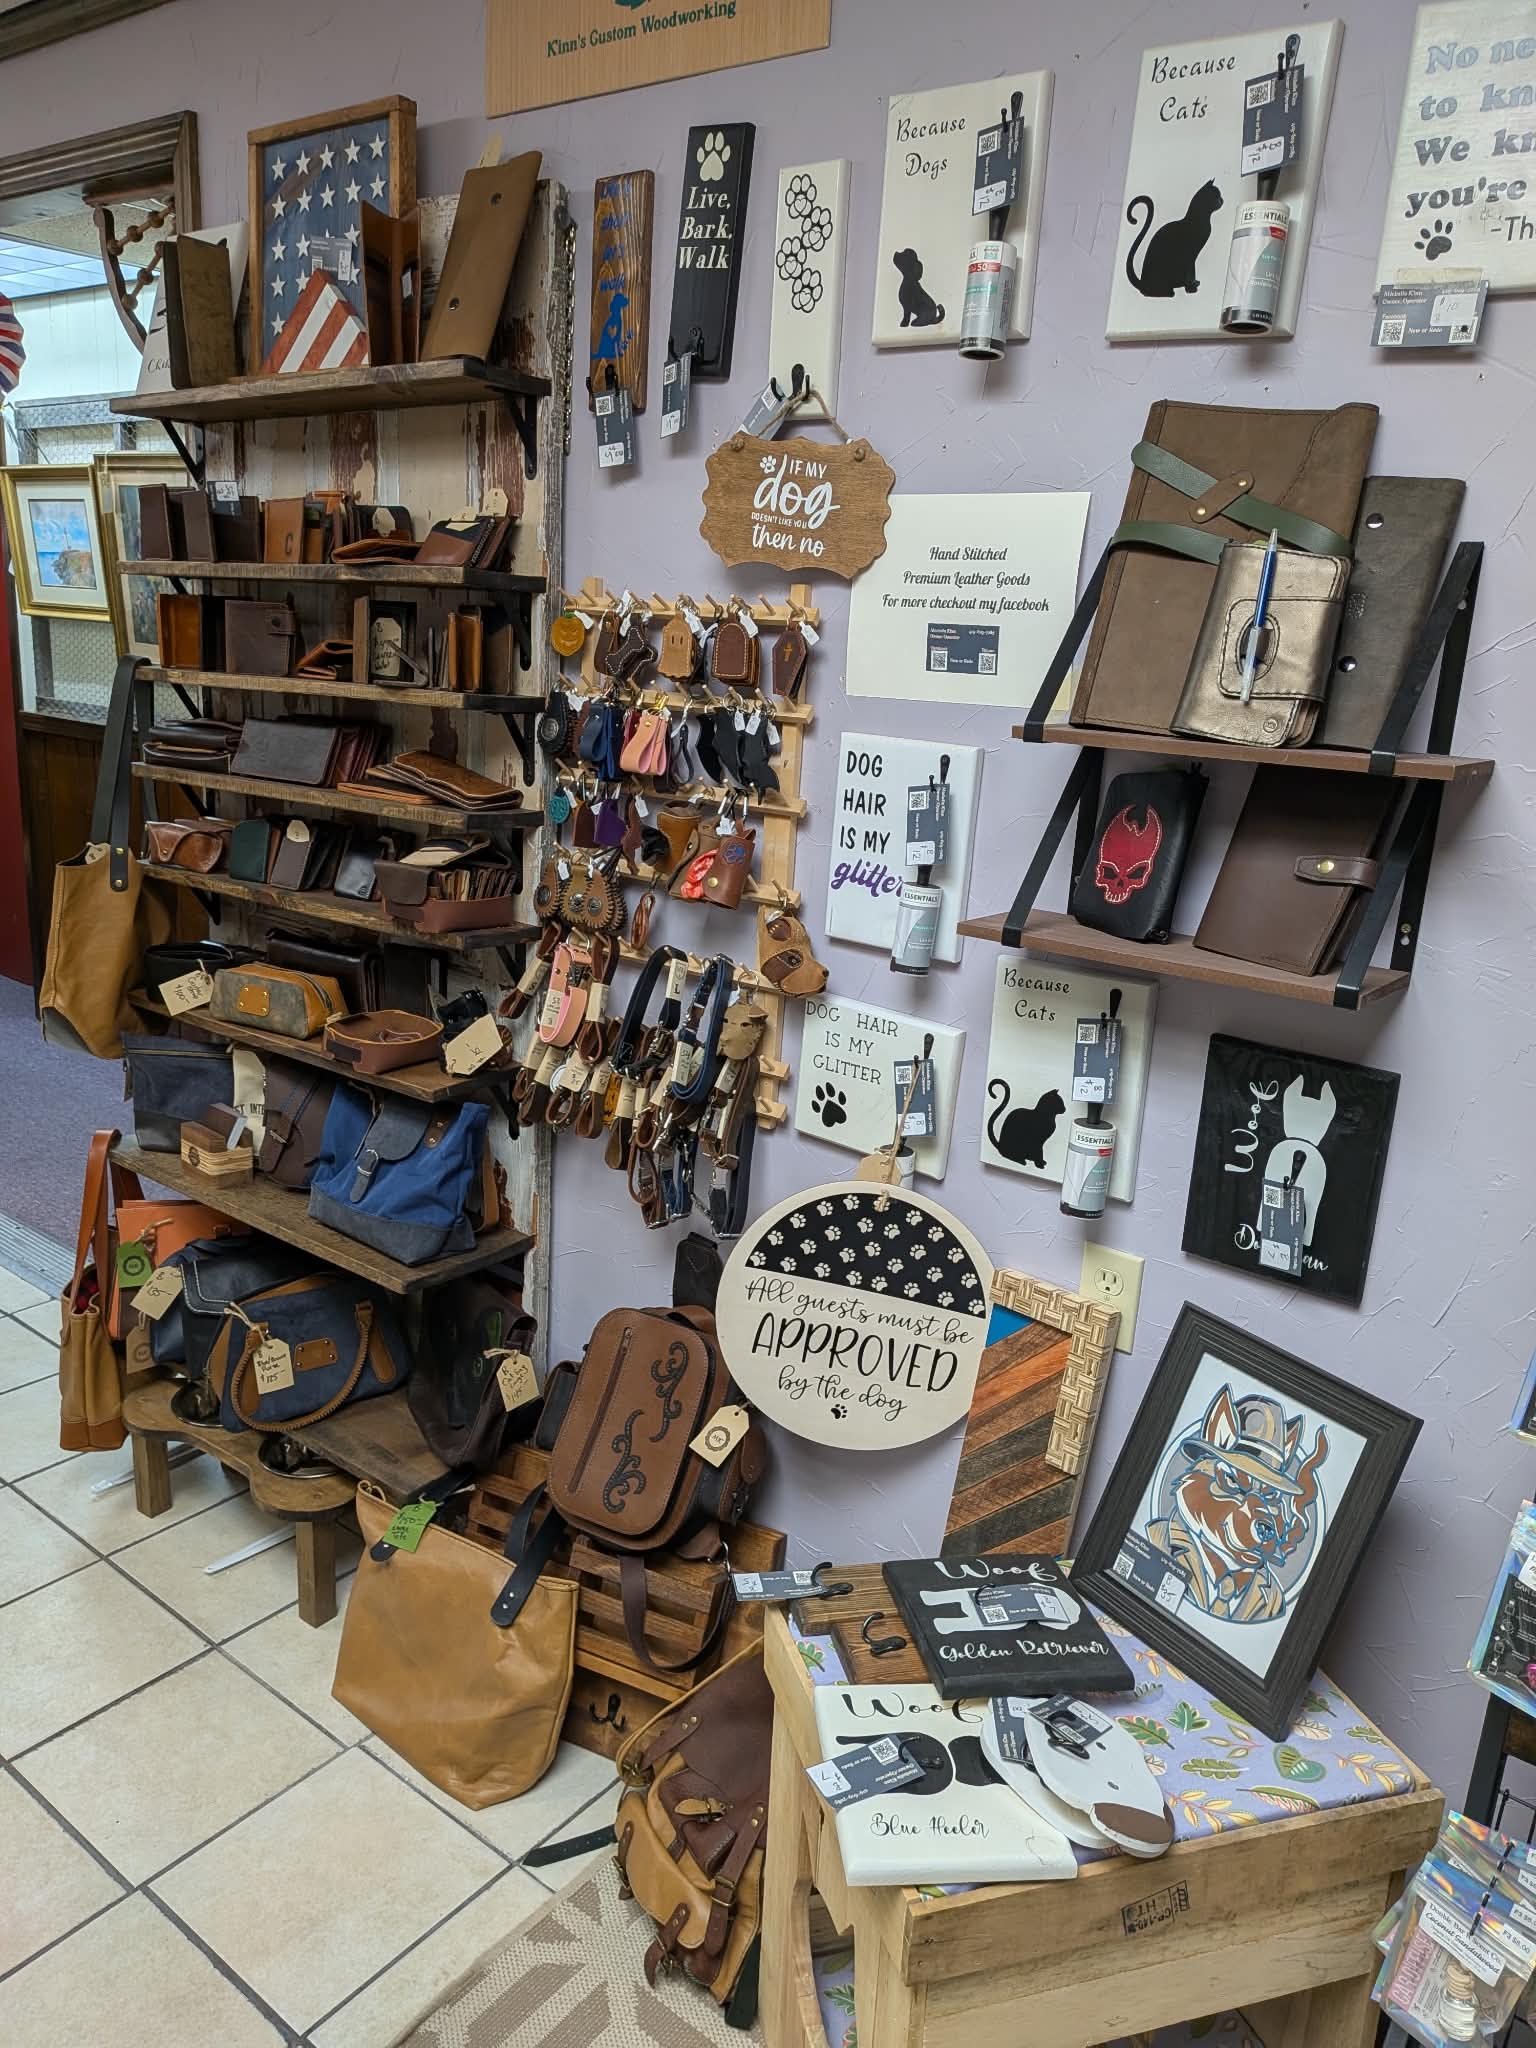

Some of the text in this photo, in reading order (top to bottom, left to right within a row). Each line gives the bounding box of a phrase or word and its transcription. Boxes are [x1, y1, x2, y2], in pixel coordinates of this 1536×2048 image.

[547, 0, 737, 57] Kinn's Custom Woodworking
[1151, 56, 1237, 84] Because
[1424, 42, 1479, 74] No
[1418, 83, 1536, 121] to kn
[896, 117, 967, 143] Because
[1414, 136, 1471, 166] We
[905, 152, 949, 180] Dogs
[686, 185, 731, 209] Live,
[1404, 176, 1528, 219] you're
[1490, 215, 1536, 241] -Th
[679, 245, 729, 269] Walk
[789, 457, 828, 479] IF MY
[753, 453, 841, 530] dog
[751, 511, 778, 525] DOESN'T
[751, 523, 827, 558] then no
[929, 546, 1009, 562] Hand Stitched
[903, 570, 1031, 589] Premium Leather Goods
[882, 594, 1050, 615] For more checkout my facebook
[846, 750, 883, 778] DOG
[843, 788, 887, 817] HAIR
[840, 825, 891, 855] IS MY
[830, 858, 903, 898] glitter
[904, 891, 939, 903] ESSENTIALS
[1003, 967, 1073, 994] Because
[806, 1001, 899, 1037] DOG HAIR
[1014, 999, 1056, 1022] Cats
[824, 1030, 875, 1057] IS MY
[812, 1053, 882, 1085] GLITTER
[1223, 1080, 1281, 1174] Woof
[1234, 1223, 1330, 1272] Doan
[745, 1275, 976, 1345] All guests must be
[751, 1310, 959, 1393] APPROVED
[778, 1364, 909, 1422] by the dog
[934, 1558, 1057, 1582] Woof
[939, 1639, 1109, 1663] Golden Retriever
[841, 1691, 983, 1724] Woof
[870, 1812, 990, 1840] Blue Heeler
[1425, 1911, 1455, 1937] Coconut
